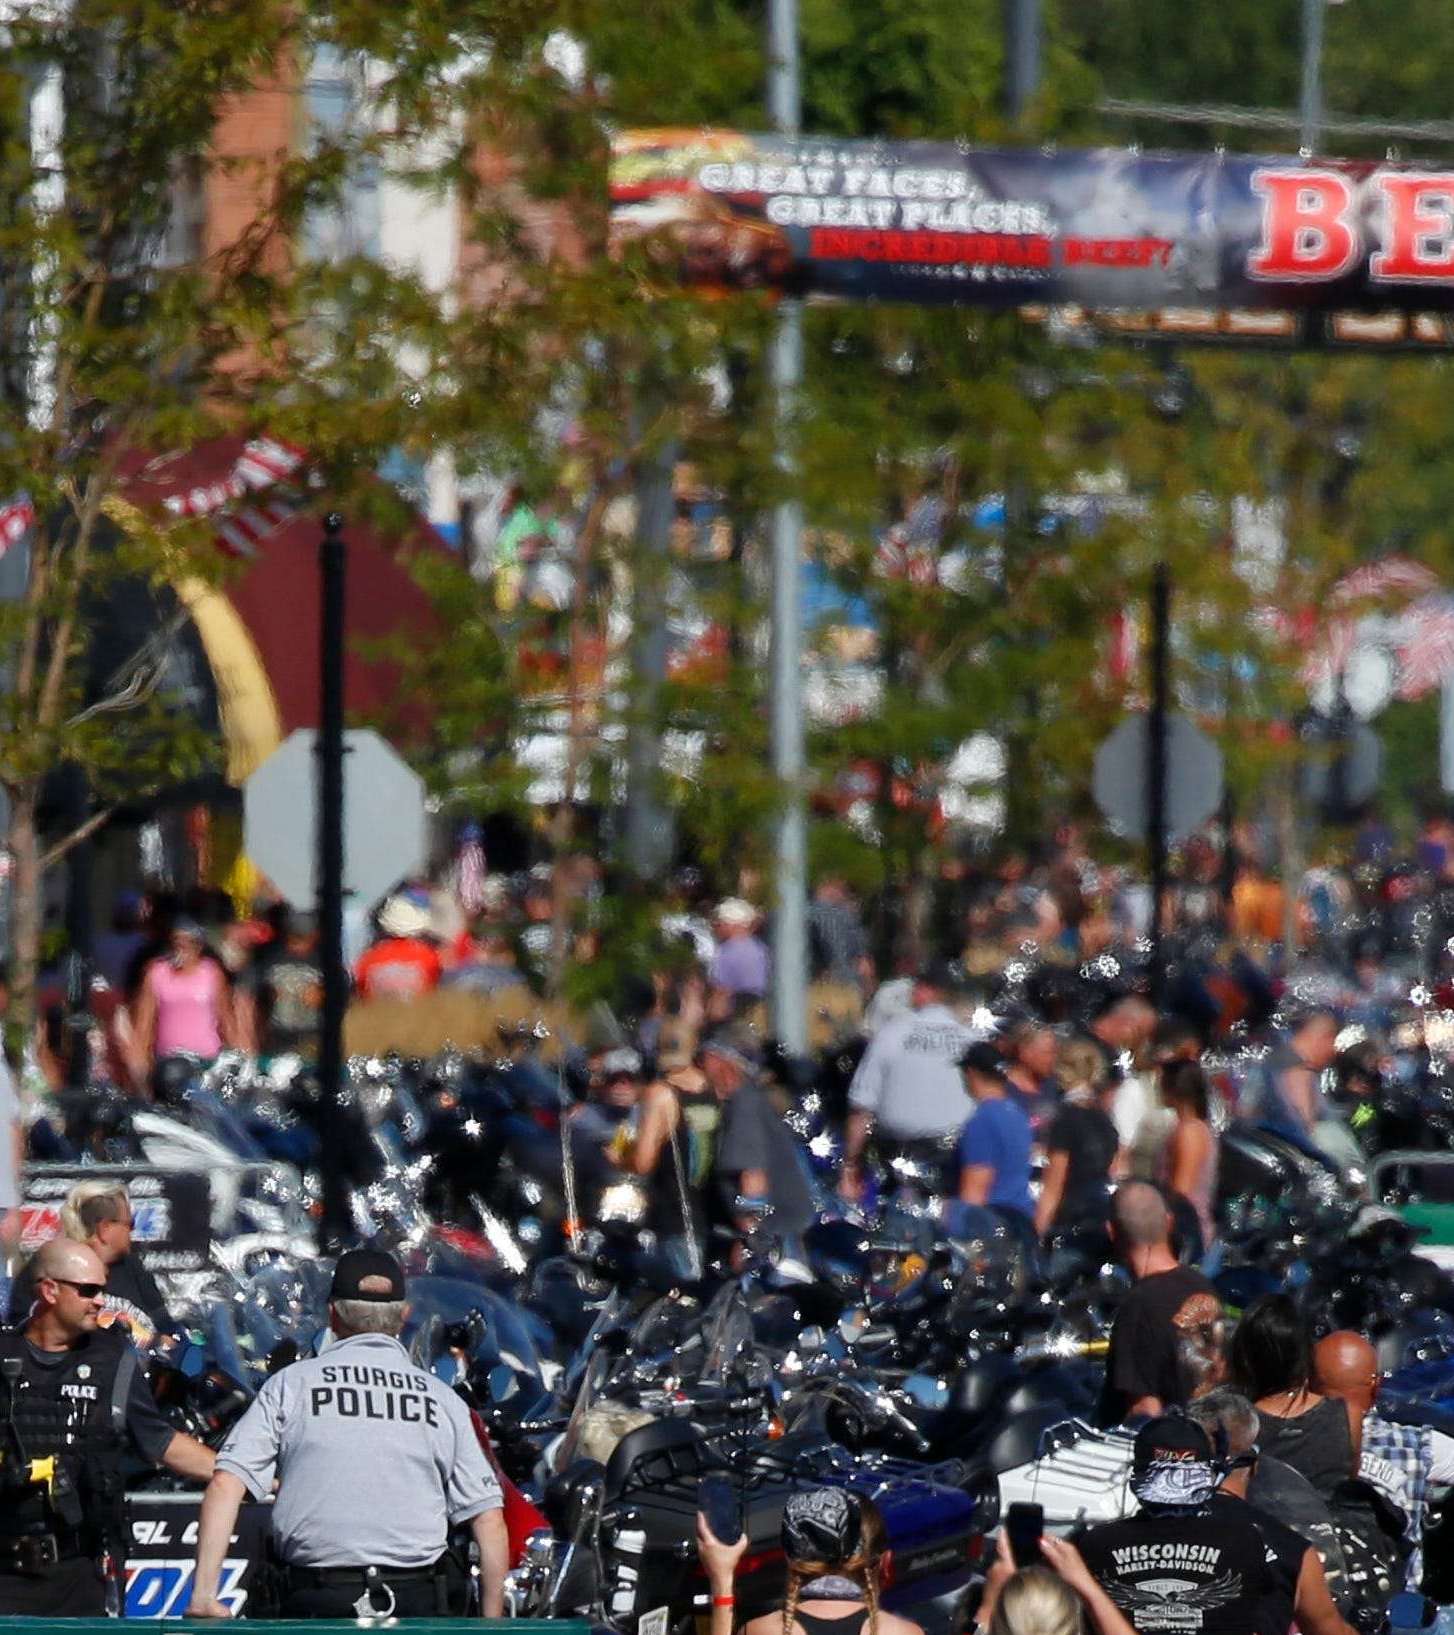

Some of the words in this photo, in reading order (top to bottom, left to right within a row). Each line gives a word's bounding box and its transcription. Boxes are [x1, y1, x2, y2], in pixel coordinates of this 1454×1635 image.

[698, 163, 835, 195] GREAT
[766, 196, 892, 229] GREAT
[61, 1384, 97, 1400] POLICE
[322, 1366, 428, 1393] STURGIS
[311, 1387, 439, 1429] POLICE
[1112, 1543, 1221, 1565] WISCONSIN
